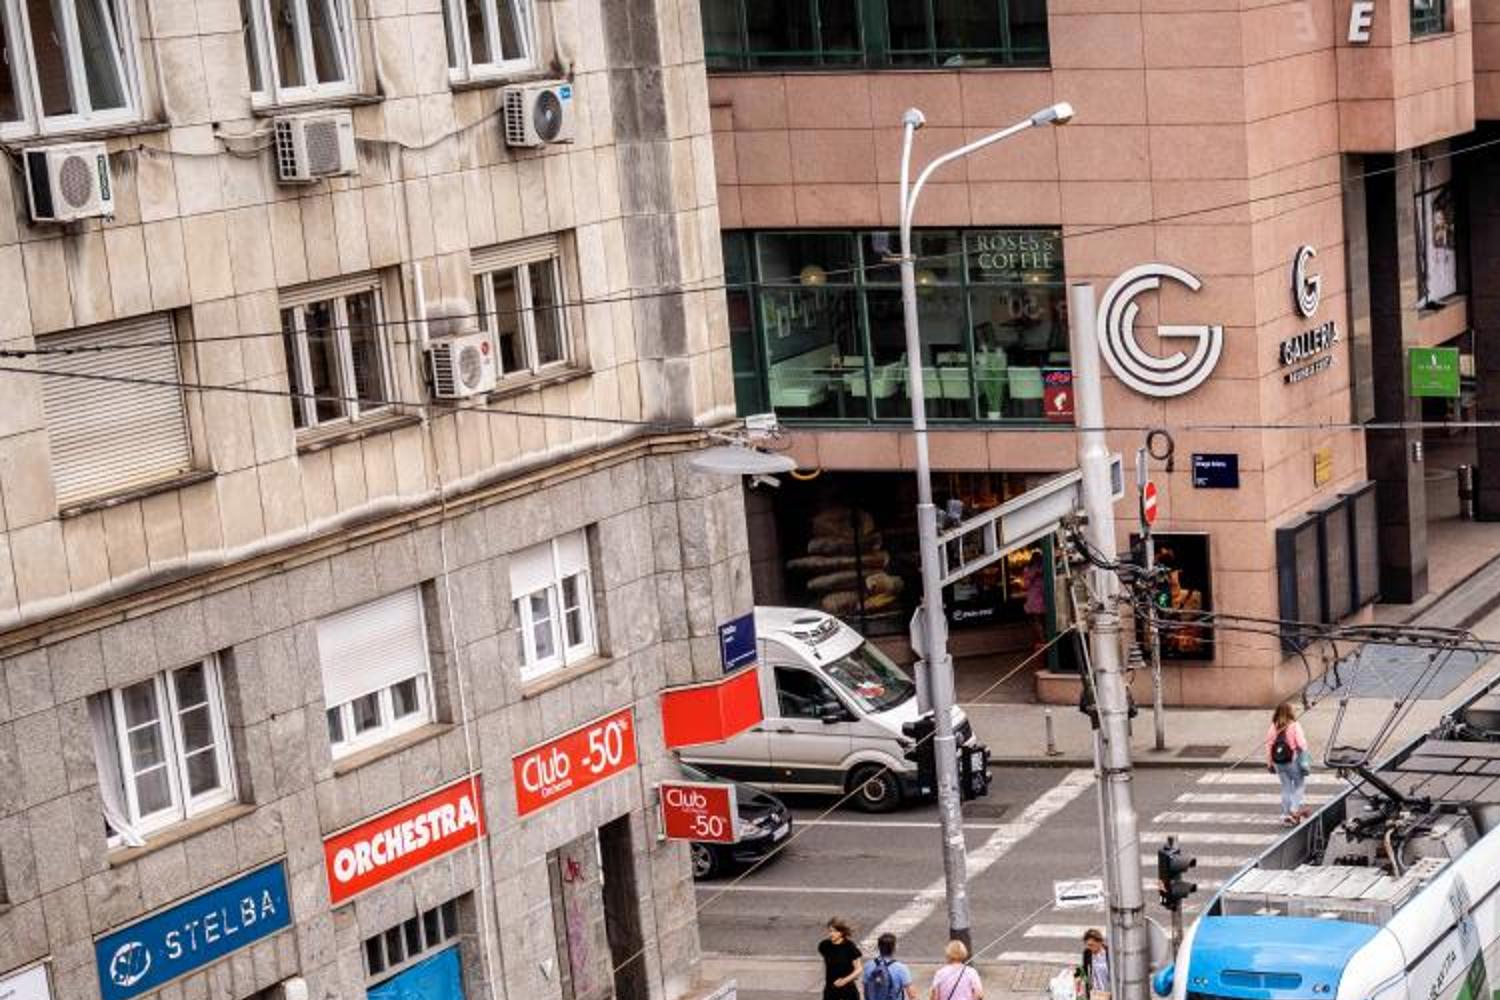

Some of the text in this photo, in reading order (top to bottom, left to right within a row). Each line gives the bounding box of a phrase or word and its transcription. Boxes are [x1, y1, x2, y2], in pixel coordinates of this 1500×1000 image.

[978, 252, 1053, 270] COFFEE
[522, 747, 570, 793] Club
[666, 789, 707, 808] Club
[332, 796, 478, 883] ORCHESTRA
[165, 889, 276, 960] STELBA
